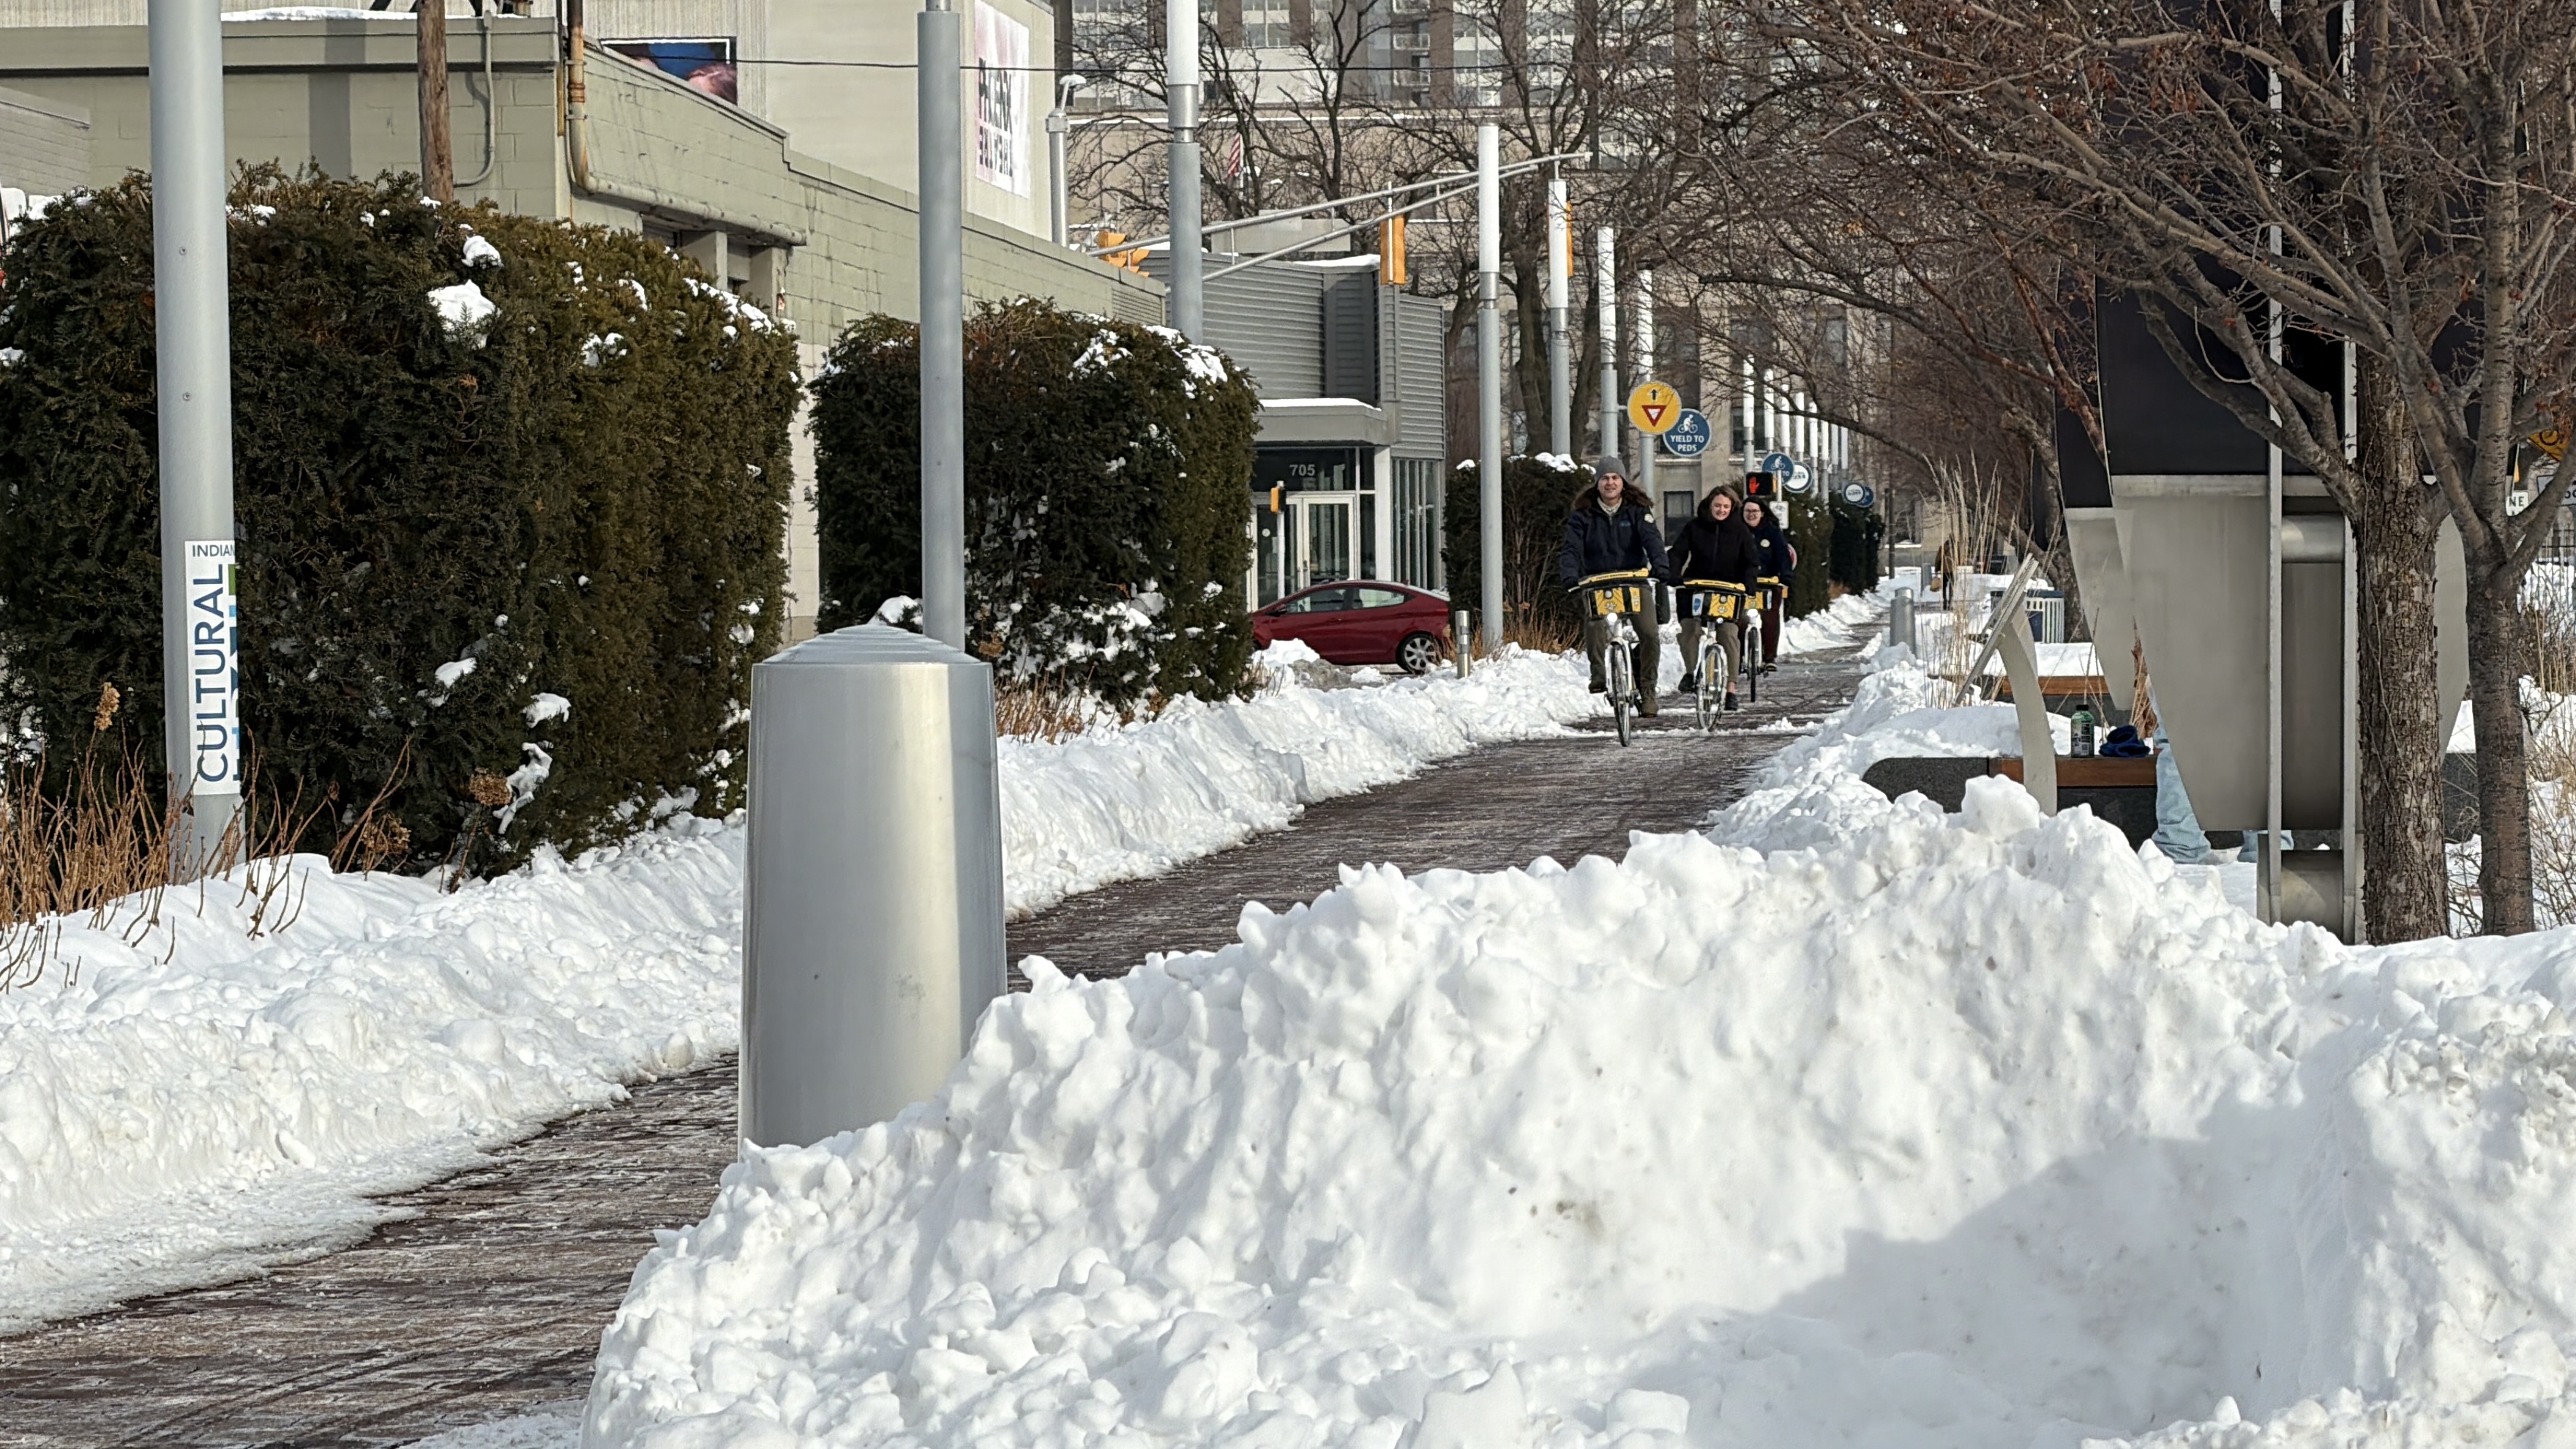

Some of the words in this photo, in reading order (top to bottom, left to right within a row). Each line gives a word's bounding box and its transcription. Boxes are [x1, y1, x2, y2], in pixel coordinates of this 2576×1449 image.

[1670, 435, 1693, 443] YIELD
[1694, 435, 1704, 443] TO
[1289, 464, 1316, 476] 705
[2509, 496, 2524, 506] NE
[192, 564, 228, 782] CULTURAL
